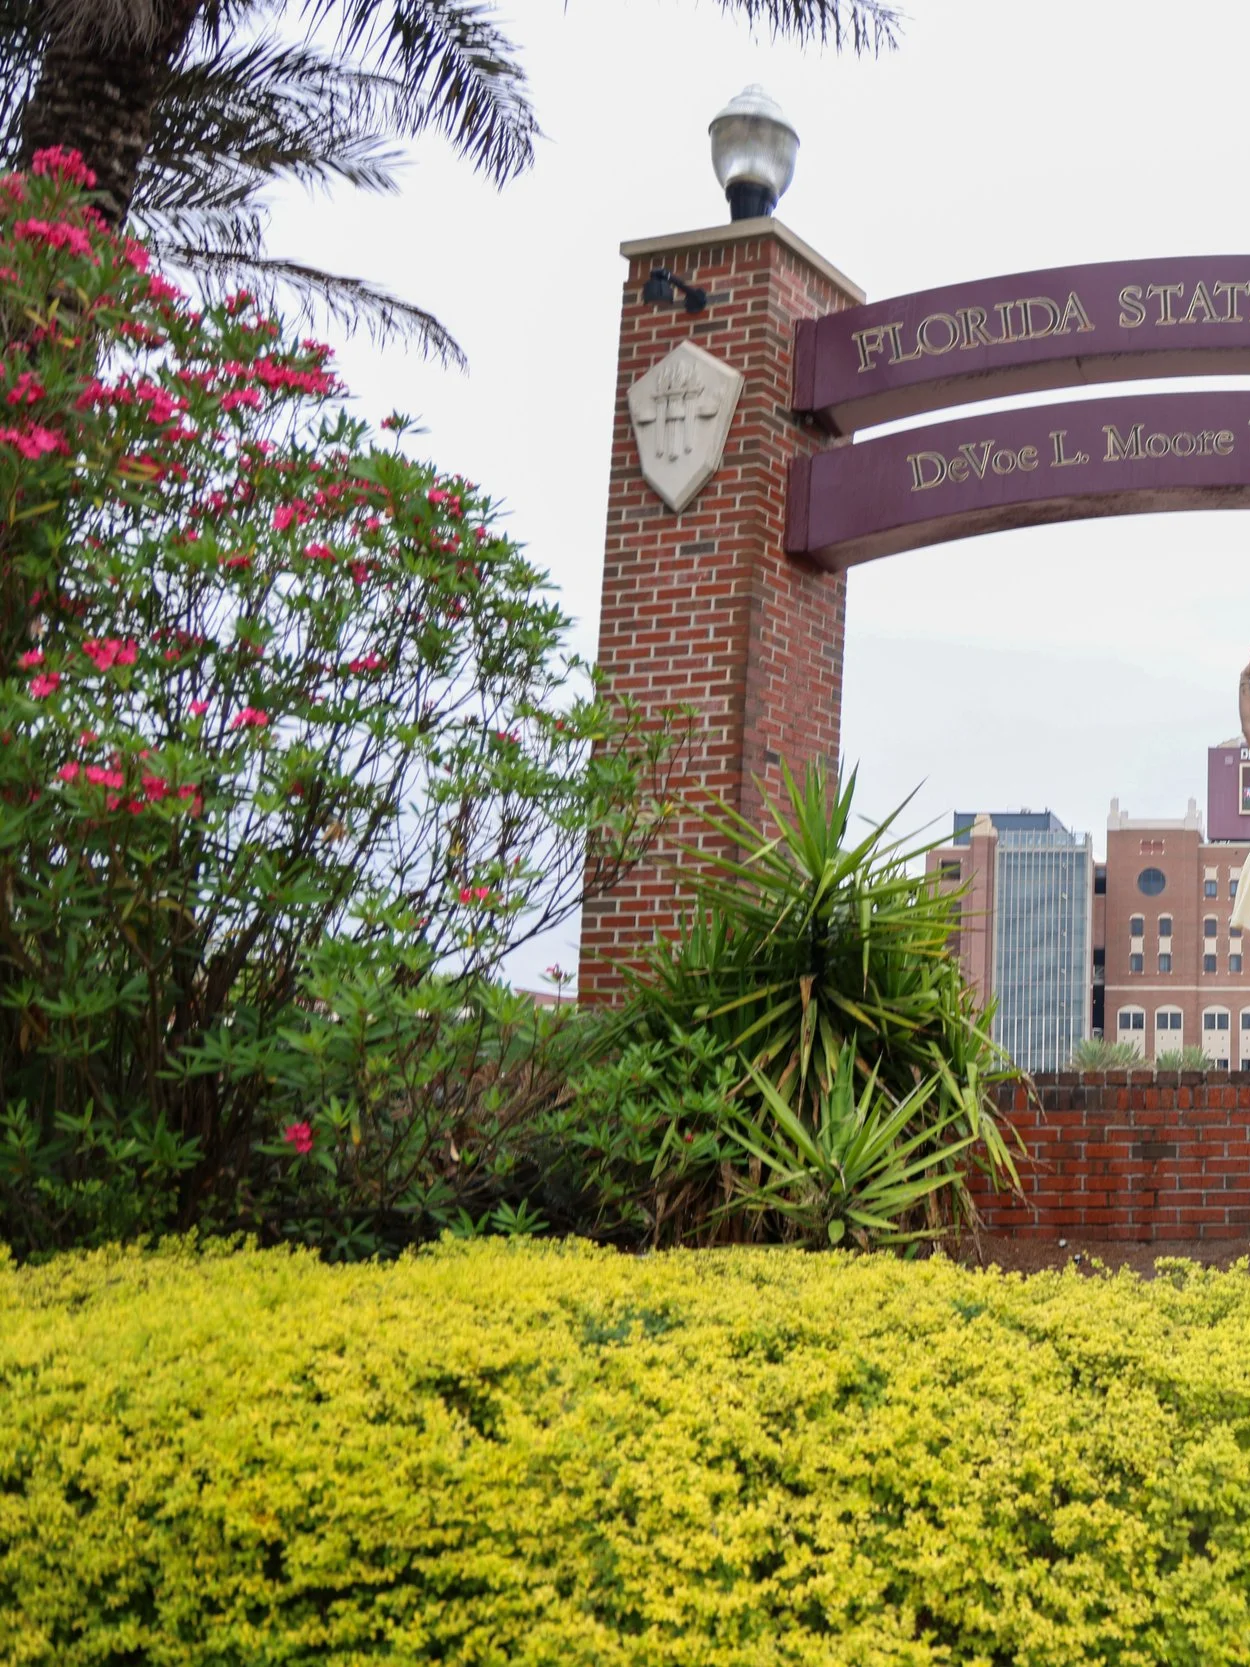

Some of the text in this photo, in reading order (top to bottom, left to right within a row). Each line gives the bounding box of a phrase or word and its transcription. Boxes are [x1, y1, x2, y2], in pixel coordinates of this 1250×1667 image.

[852, 291, 1095, 374] FLORIDA
[907, 440, 1039, 492] DeVoe
[1049, 430, 1090, 467] L.
[1102, 423, 1234, 462] Moore
